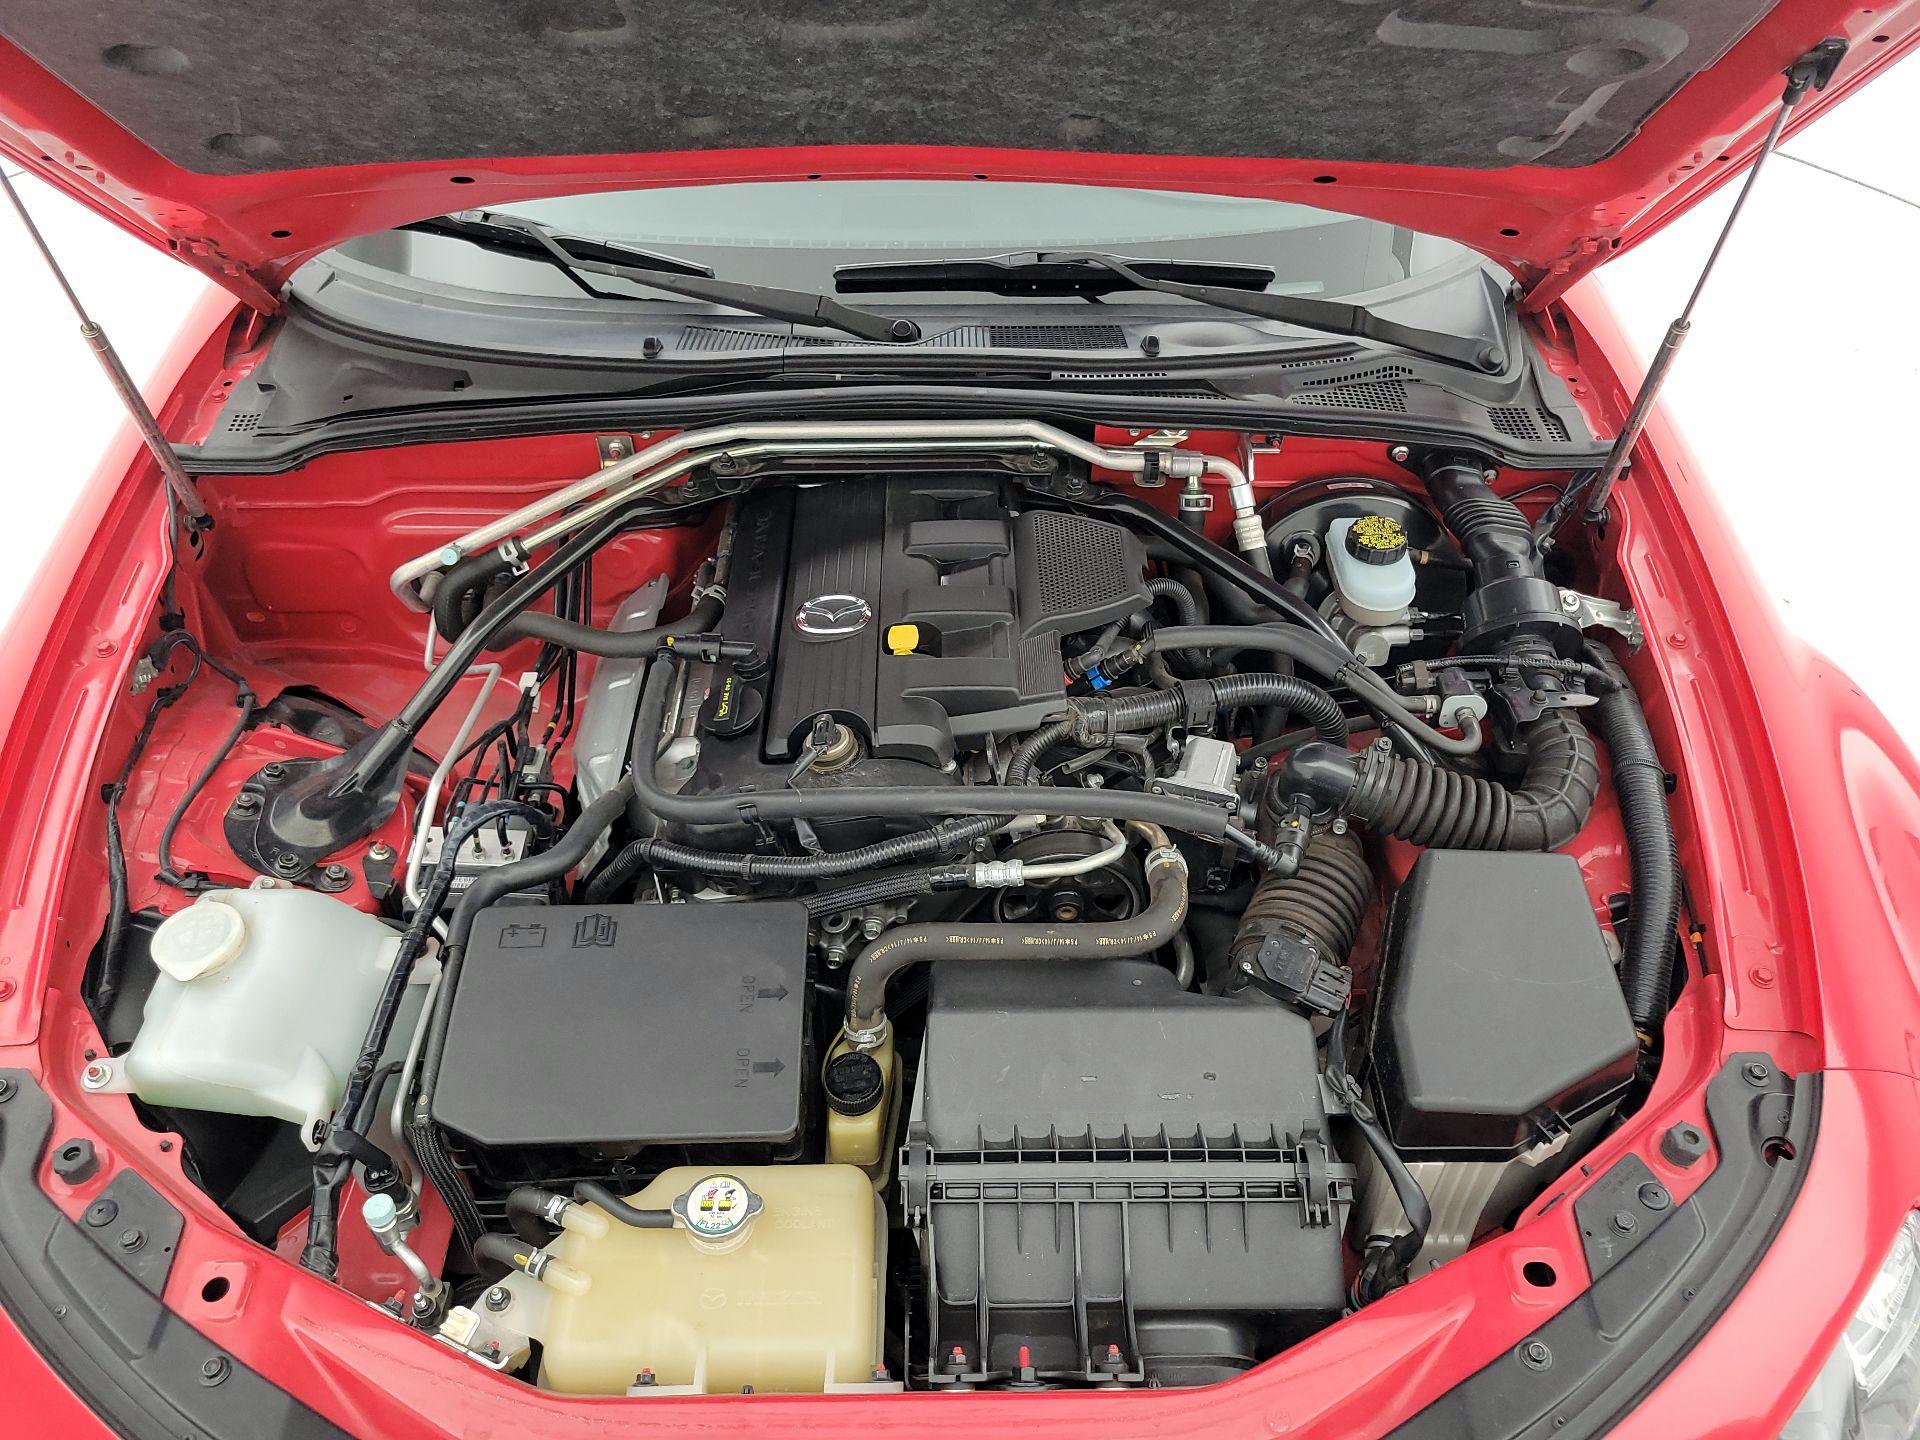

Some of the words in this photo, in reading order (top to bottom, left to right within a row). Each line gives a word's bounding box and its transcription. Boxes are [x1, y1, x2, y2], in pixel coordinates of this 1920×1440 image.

[738, 974, 757, 1014] OPEN
[735, 1047, 751, 1089] OPEN
[699, 1219, 721, 1229] FL22
